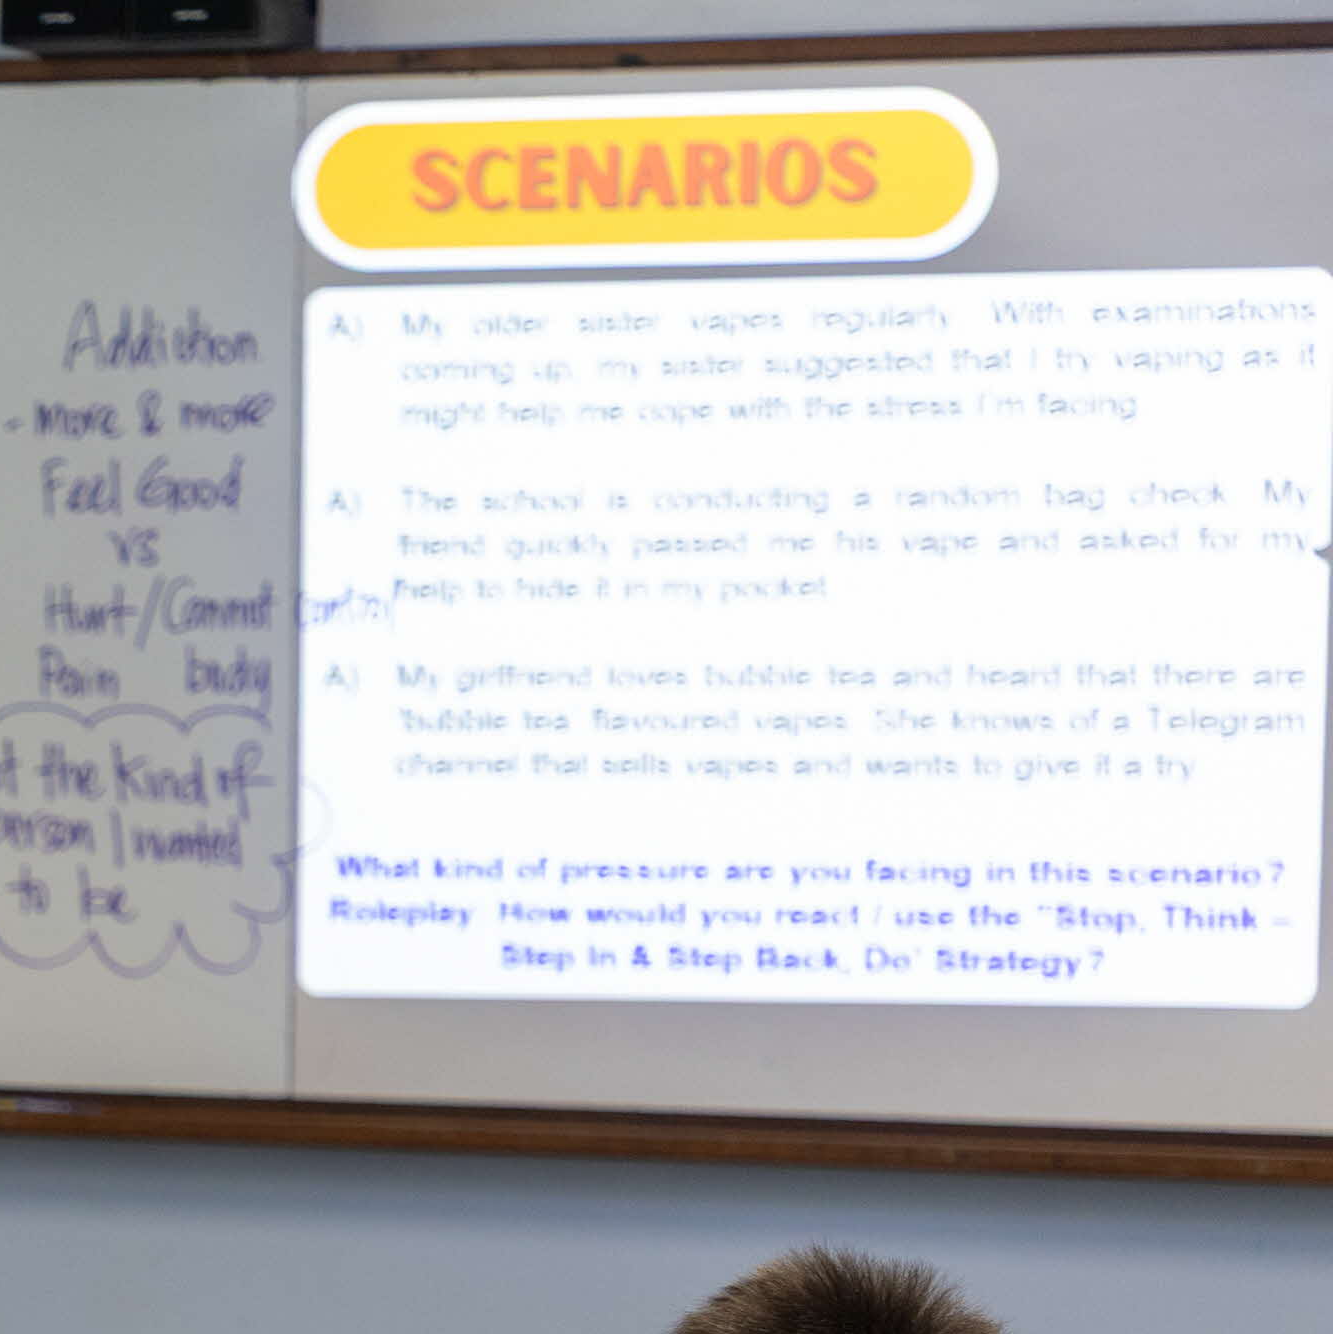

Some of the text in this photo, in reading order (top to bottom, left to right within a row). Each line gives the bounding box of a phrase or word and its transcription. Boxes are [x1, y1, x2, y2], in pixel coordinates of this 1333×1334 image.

[411, 138, 877, 213] SCENARIOS
[402, 313, 443, 339] My
[690, 311, 782, 335] vapes
[992, 301, 1063, 324] With
[1092, 299, 1315, 324] examinations
[401, 359, 513, 384] coming
[597, 360, 640, 384] my
[662, 357, 743, 377] sister
[764, 351, 933, 379] suggested
[951, 348, 1011, 372] that
[1056, 347, 1090, 372] try
[1115, 347, 1224, 373] vaping
[1242, 348, 1280, 367] as
[1300, 343, 1315, 367] it
[36, 402, 122, 439] more
[179, 391, 273, 430] more
[401, 395, 962, 429] might help me cope with the stress
[41, 455, 245, 517] Feel Good
[402, 488, 457, 512] The
[481, 490, 583, 512] school
[608, 491, 628, 511] is
[653, 488, 830, 514] conducting
[853, 488, 870, 508] a
[895, 483, 1021, 507] random
[1264, 480, 1308, 507] My
[398, 534, 485, 557] friend
[632, 532, 747, 558] passed
[769, 532, 815, 553] me
[837, 531, 880, 552] his
[902, 531, 978, 557] vape
[999, 530, 1058, 552] and
[1079, 528, 1179, 550] asked
[1198, 528, 1238, 550] for
[1261, 529, 1309, 554] my
[477, 579, 501, 599] to
[516, 577, 579, 599] hide
[597, 578, 611, 598] it
[624, 579, 649, 598] in
[662, 578, 704, 603] my
[38, 644, 120, 700] Pain
[397, 664, 1305, 693] My girlfriend loves bubble tea and heard that there are
[592, 708, 1304, 736] flavoured She knows of a Telegram
[40, 741, 104, 800] the
[216, 739, 276, 821] of
[397, 754, 1141, 780] channel that sells vapes and wants to give it a
[336, 856, 1285, 888] What kind of pressure are you facing in this scenario?
[7, 863, 137, 923] to be
[500, 901, 571, 924] How
[586, 903, 685, 925] would
[701, 906, 762, 928] you
[775, 906, 860, 928] react
[895, 907, 955, 927] use
[968, 906, 1021, 927] the
[1163, 904, 1258, 930] Think
[501, 944, 573, 972] Step
[589, 946, 616, 968] In
[632, 946, 650, 967] &
[669, 947, 741, 974] Step
[937, 949, 1105, 978] Strategy?
